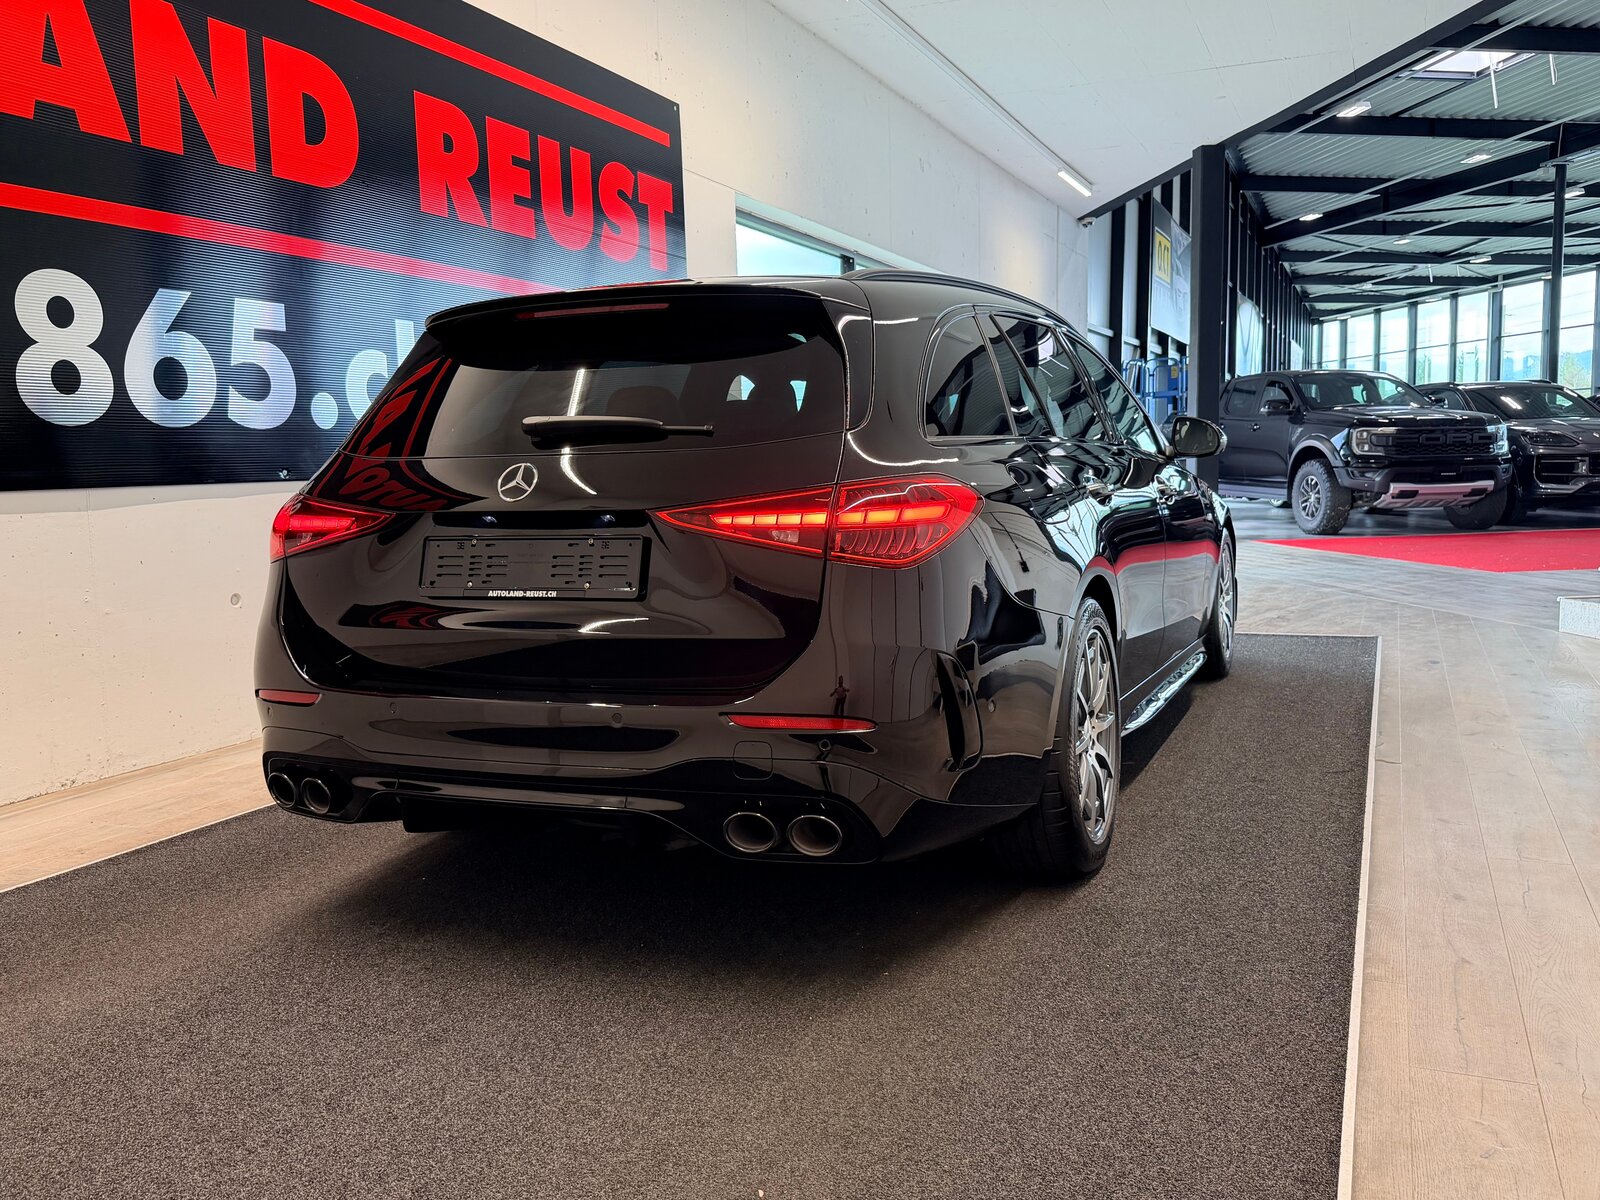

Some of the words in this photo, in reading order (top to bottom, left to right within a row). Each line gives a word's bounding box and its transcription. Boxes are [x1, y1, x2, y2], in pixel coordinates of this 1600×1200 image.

[0, 0, 359, 188] AND
[413, 91, 673, 271] REUST
[15, 268, 417, 429] 865.c
[1390, 432, 1497, 446] FORD
[487, 590, 557, 598] AUTOLAND-REUST.CH
